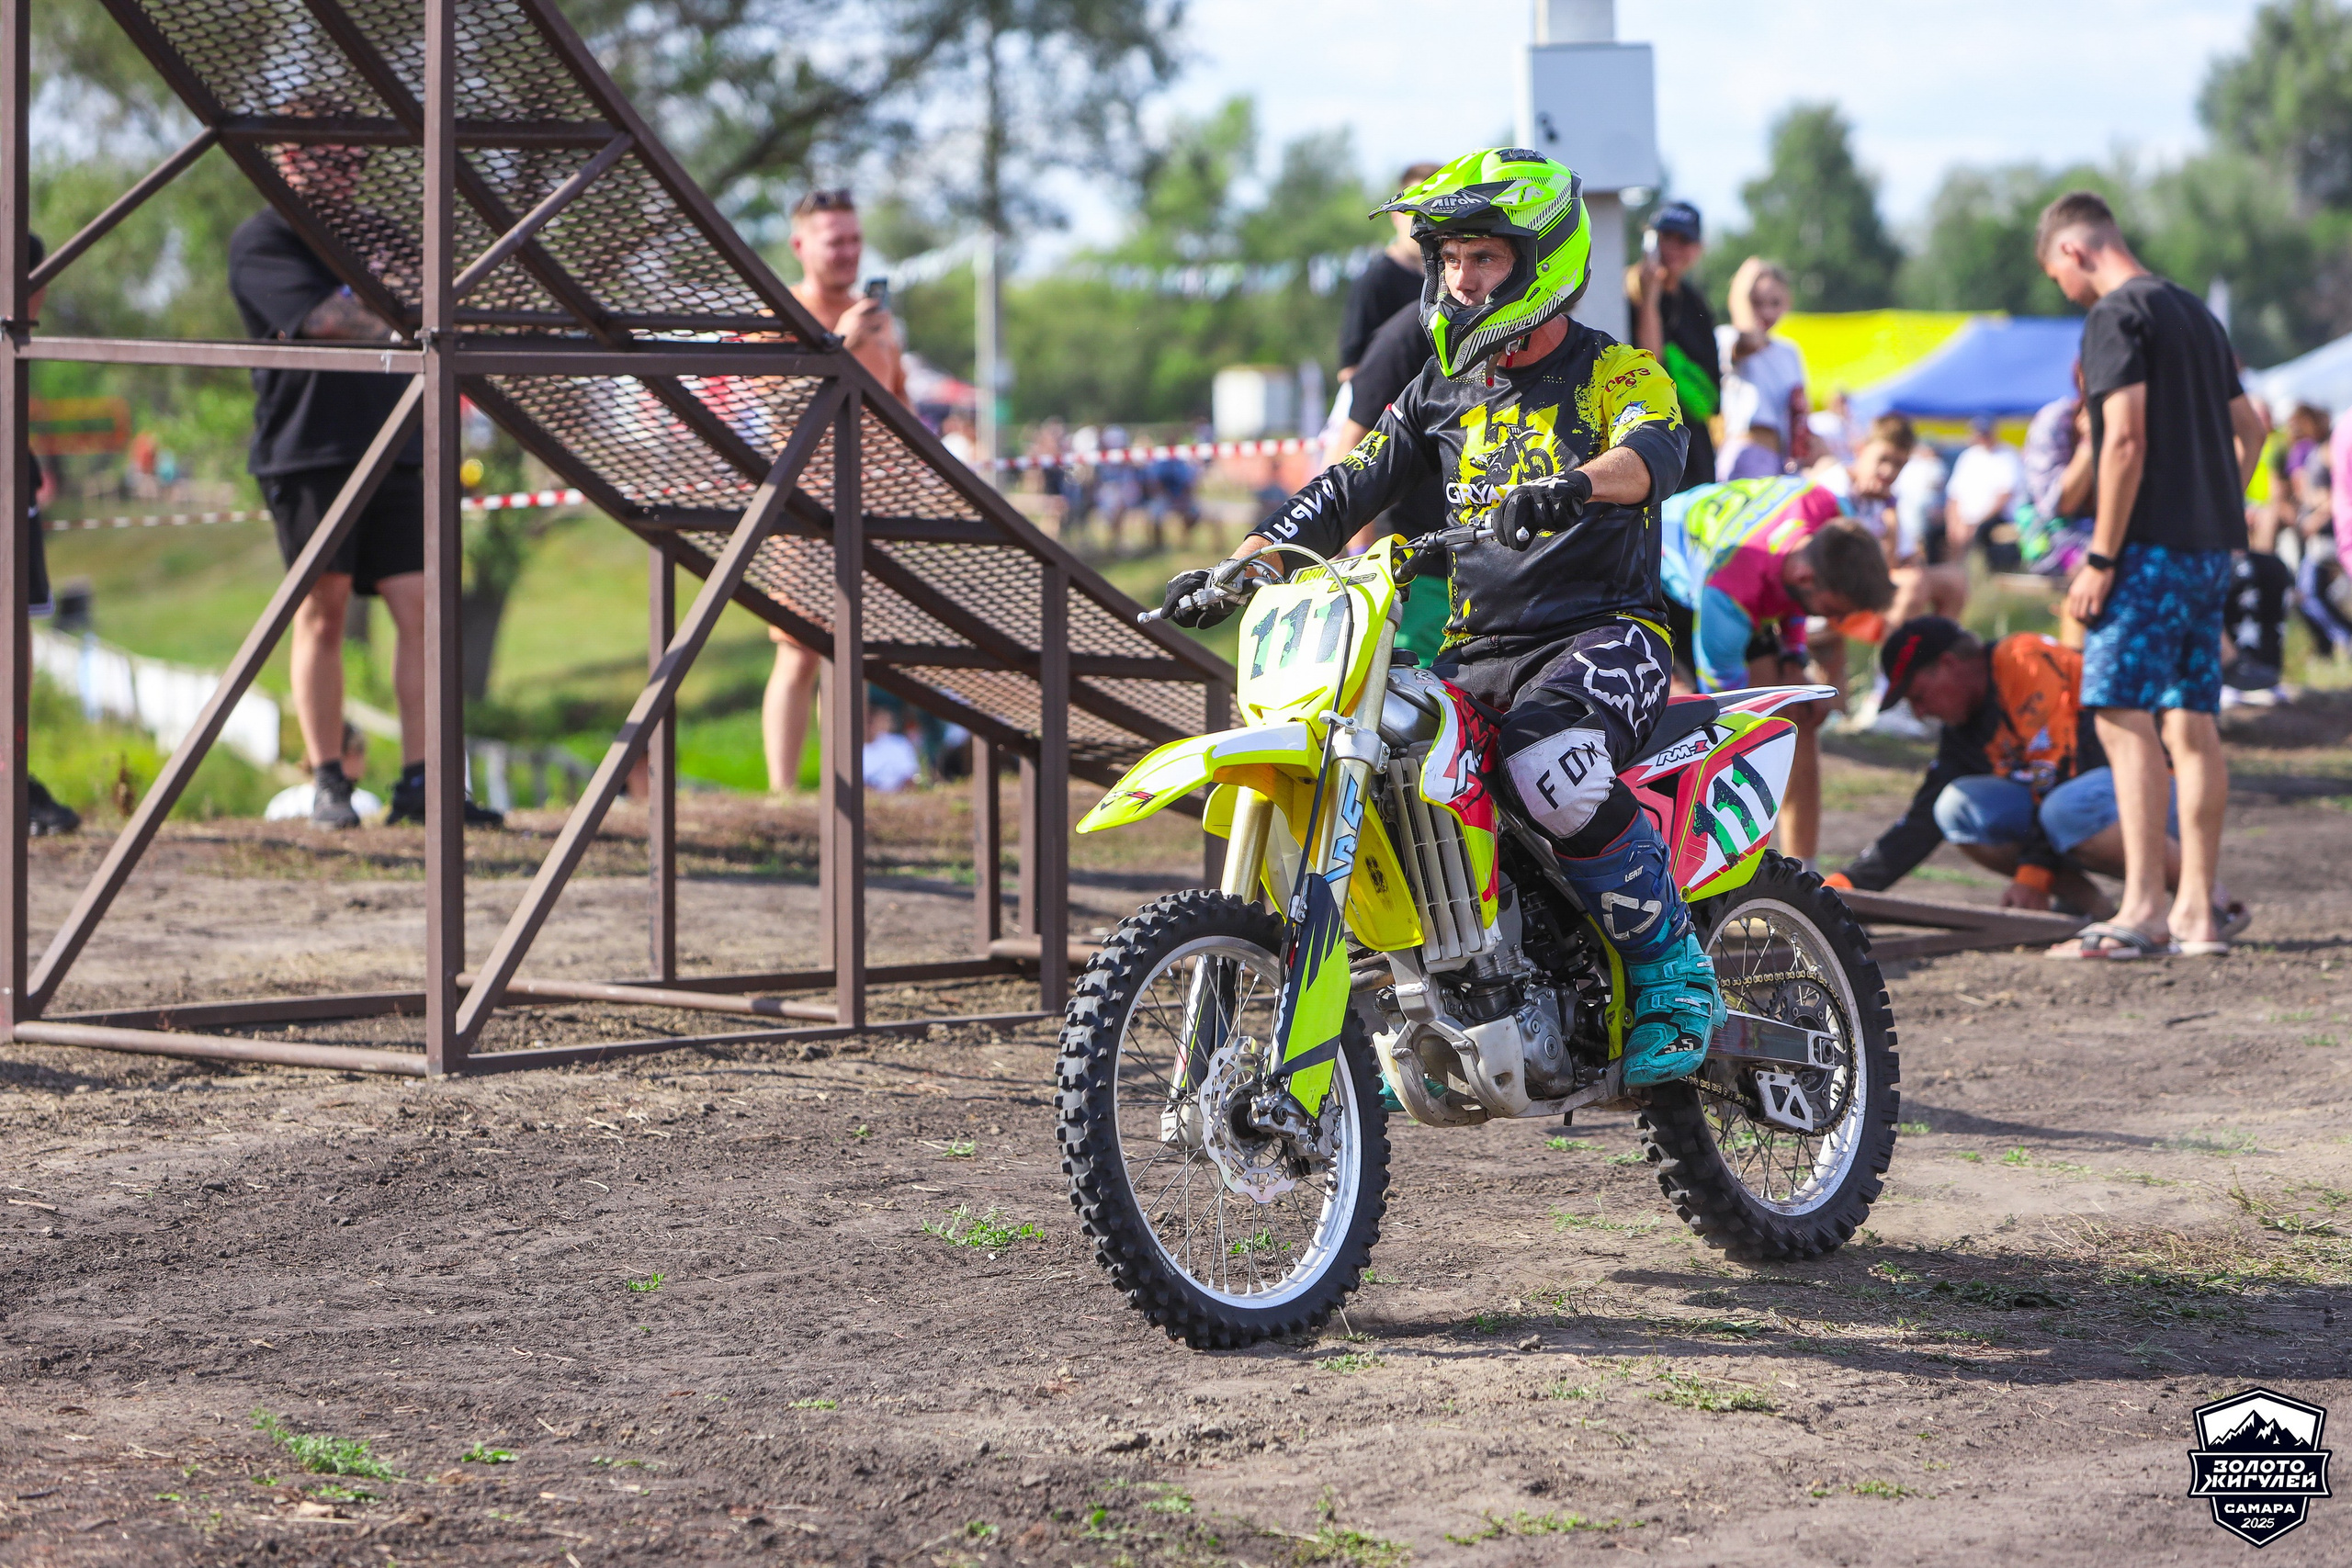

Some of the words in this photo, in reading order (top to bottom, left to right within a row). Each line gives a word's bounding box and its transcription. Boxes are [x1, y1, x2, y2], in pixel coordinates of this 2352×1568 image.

[1250, 595, 1348, 681] 111
[1535, 740, 1599, 810] FOX
[1656, 739, 1711, 766] RM-Z
[1691, 751, 1779, 871] 111
[1663, 1038, 1694, 1054] 5.5
